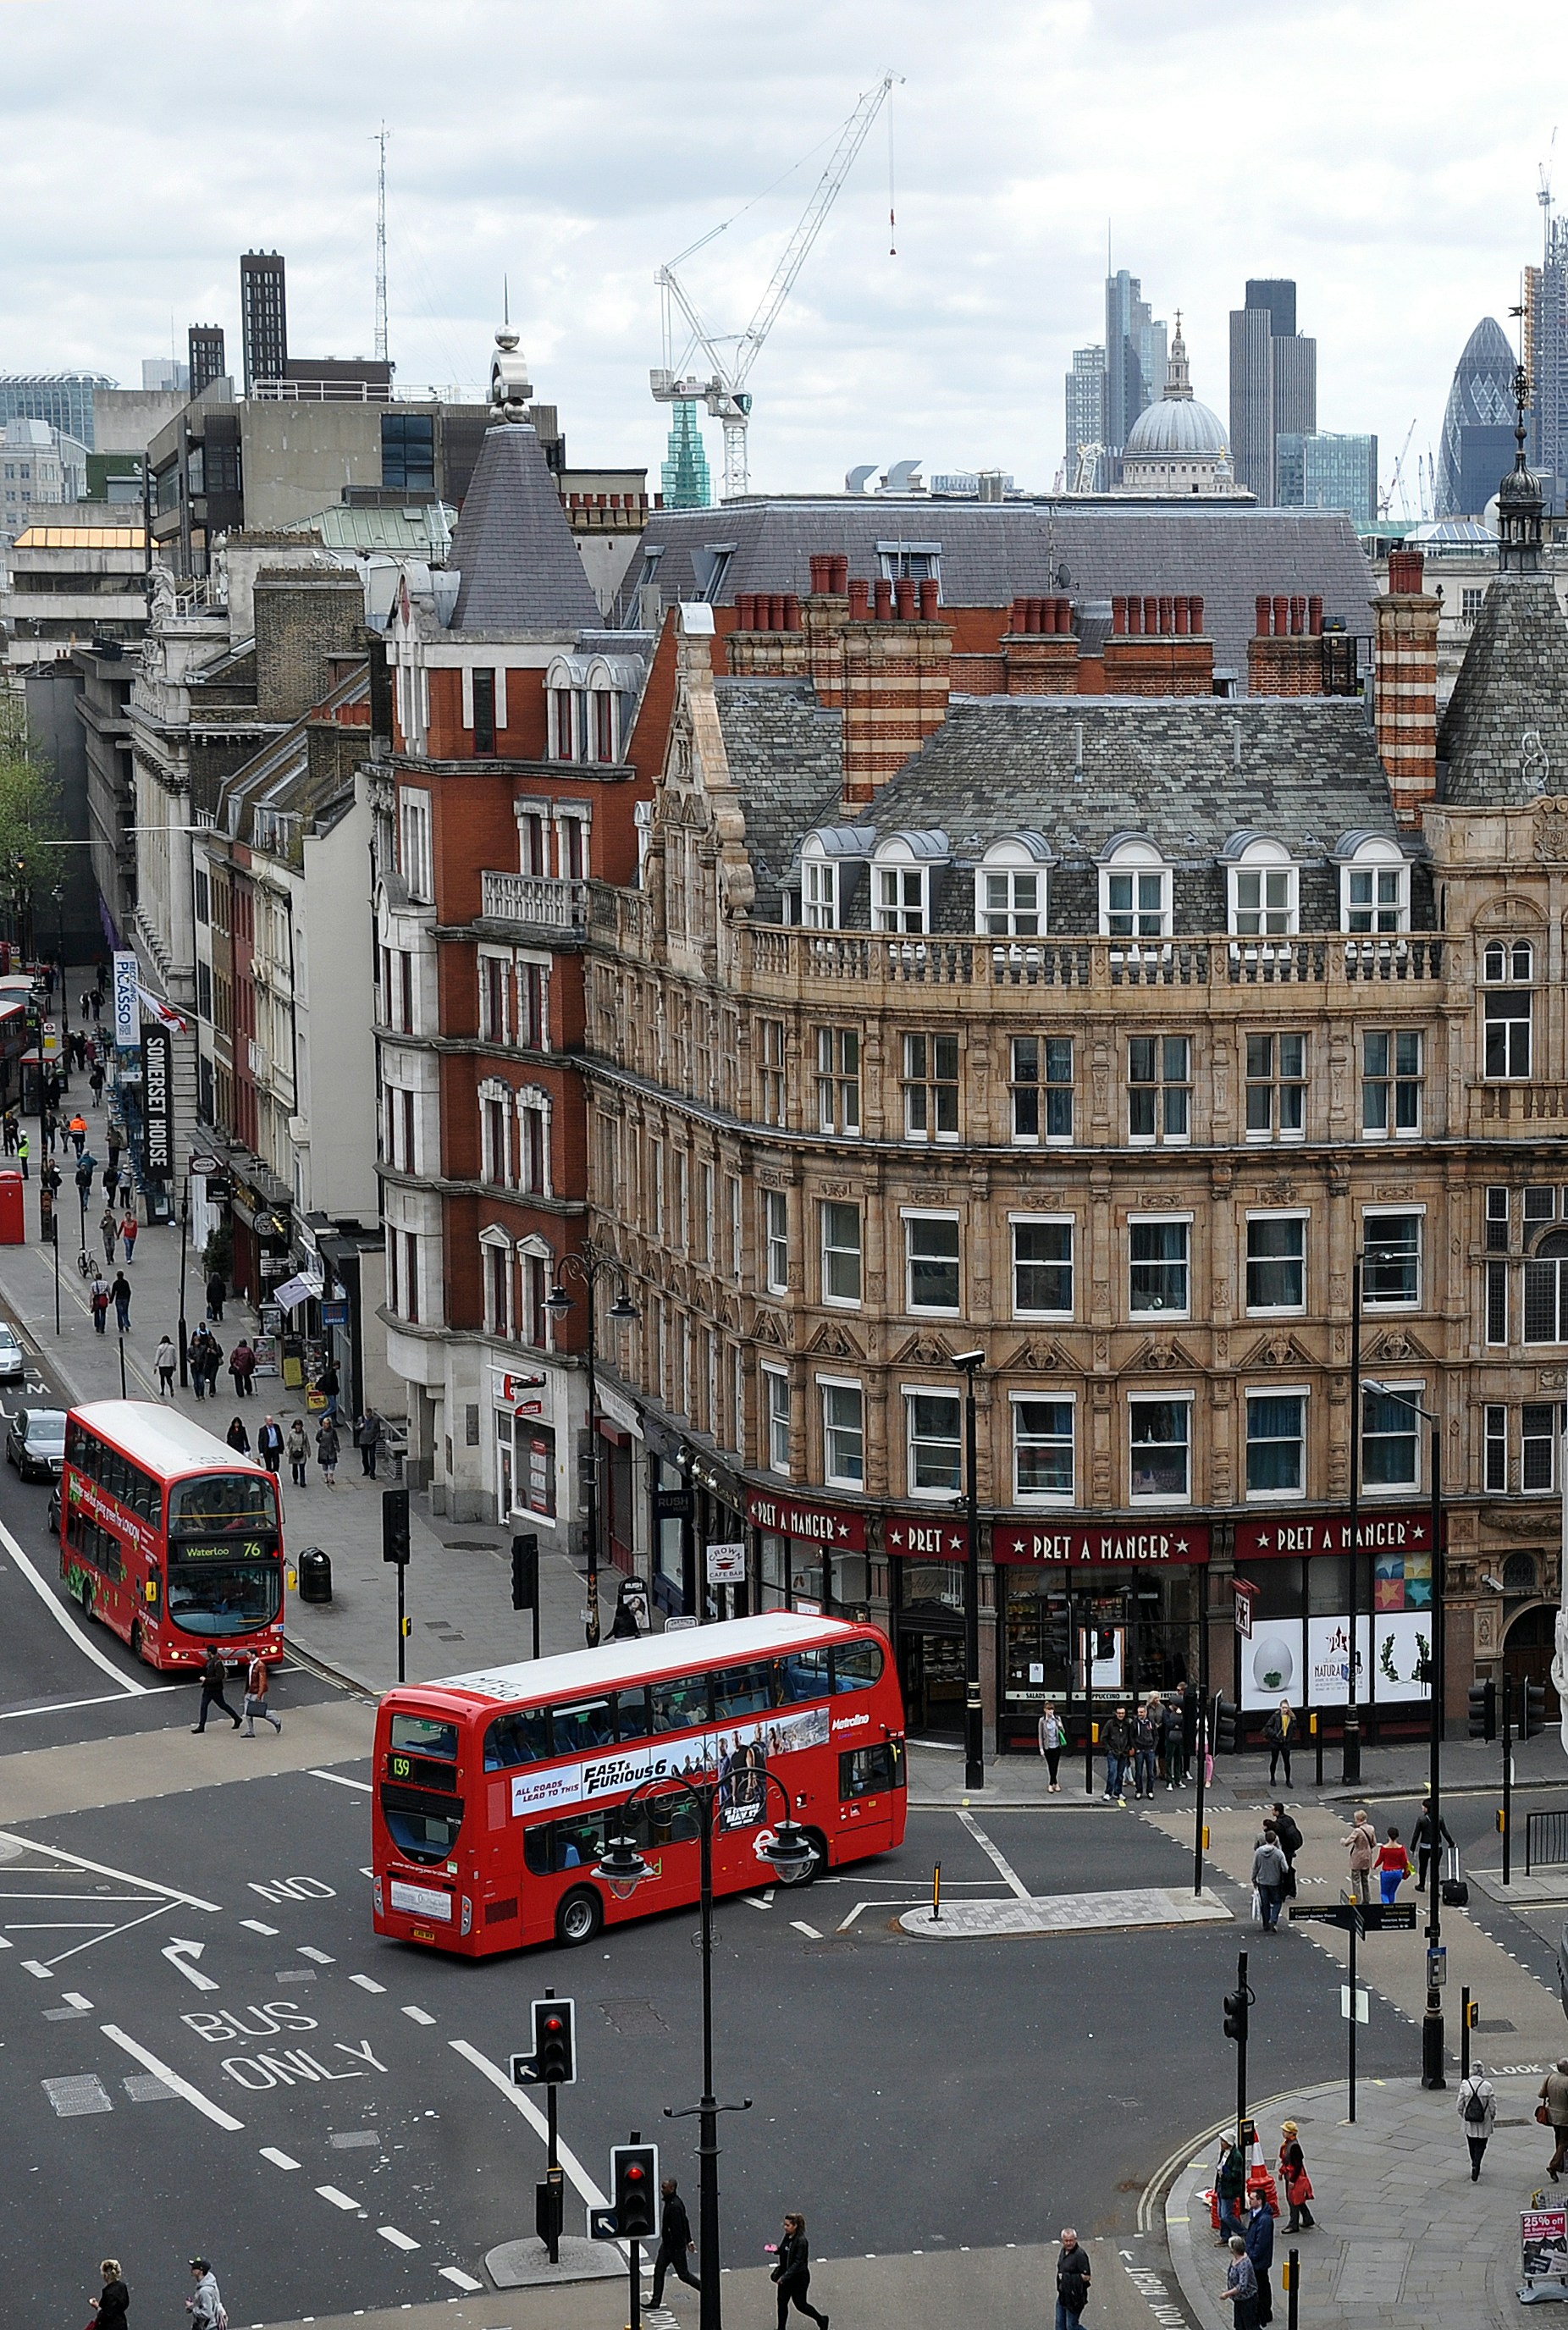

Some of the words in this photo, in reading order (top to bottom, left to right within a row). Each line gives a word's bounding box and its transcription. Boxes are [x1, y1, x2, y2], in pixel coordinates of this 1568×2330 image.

[116, 961, 131, 1024] PICASSO
[146, 1037, 166, 1114] SOMERSET
[148, 1119, 168, 1167] HOUSE
[658, 1497, 689, 1508] RUSH
[757, 1500, 777, 1527] PRET
[780, 1510, 787, 1530] A
[790, 1510, 835, 1541] MANGER
[908, 1527, 943, 1553] PRET
[1033, 1534, 1072, 1560] PRET
[1080, 1537, 1091, 1560] A
[1101, 1534, 1169, 1560] MANGER
[1278, 1527, 1314, 1551] PRET
[1322, 1527, 1333, 1549] A
[1342, 1522, 1406, 1549] MANGER
[186, 1548, 229, 1557] Waterloo
[243, 1543, 261, 1557] 76
[709, 1547, 743, 1562] CROWN
[1314, 1664, 1341, 1677] NATURA
[394, 1758, 410, 1776] 139
[583, 1759, 626, 1782] FAST
[624, 1762, 632, 1770] &
[587, 1765, 654, 1794] FURIOUS
[655, 1759, 667, 1775] 6
[516, 1787, 531, 1797] ALL
[533, 1780, 563, 1792] ROADS
[522, 1792, 545, 1803] LEAD
[561, 1784, 579, 1794] THIS
[246, 1876, 337, 1903] NO
[179, 2001, 318, 2042] BUS
[221, 2040, 389, 2090] ONLY
[1490, 2064, 1543, 2075] LOOK
[1524, 2216, 1550, 2228] 25%
[1552, 2217, 1563, 2225] off
[1124, 2267, 1169, 2295] RIGHT
